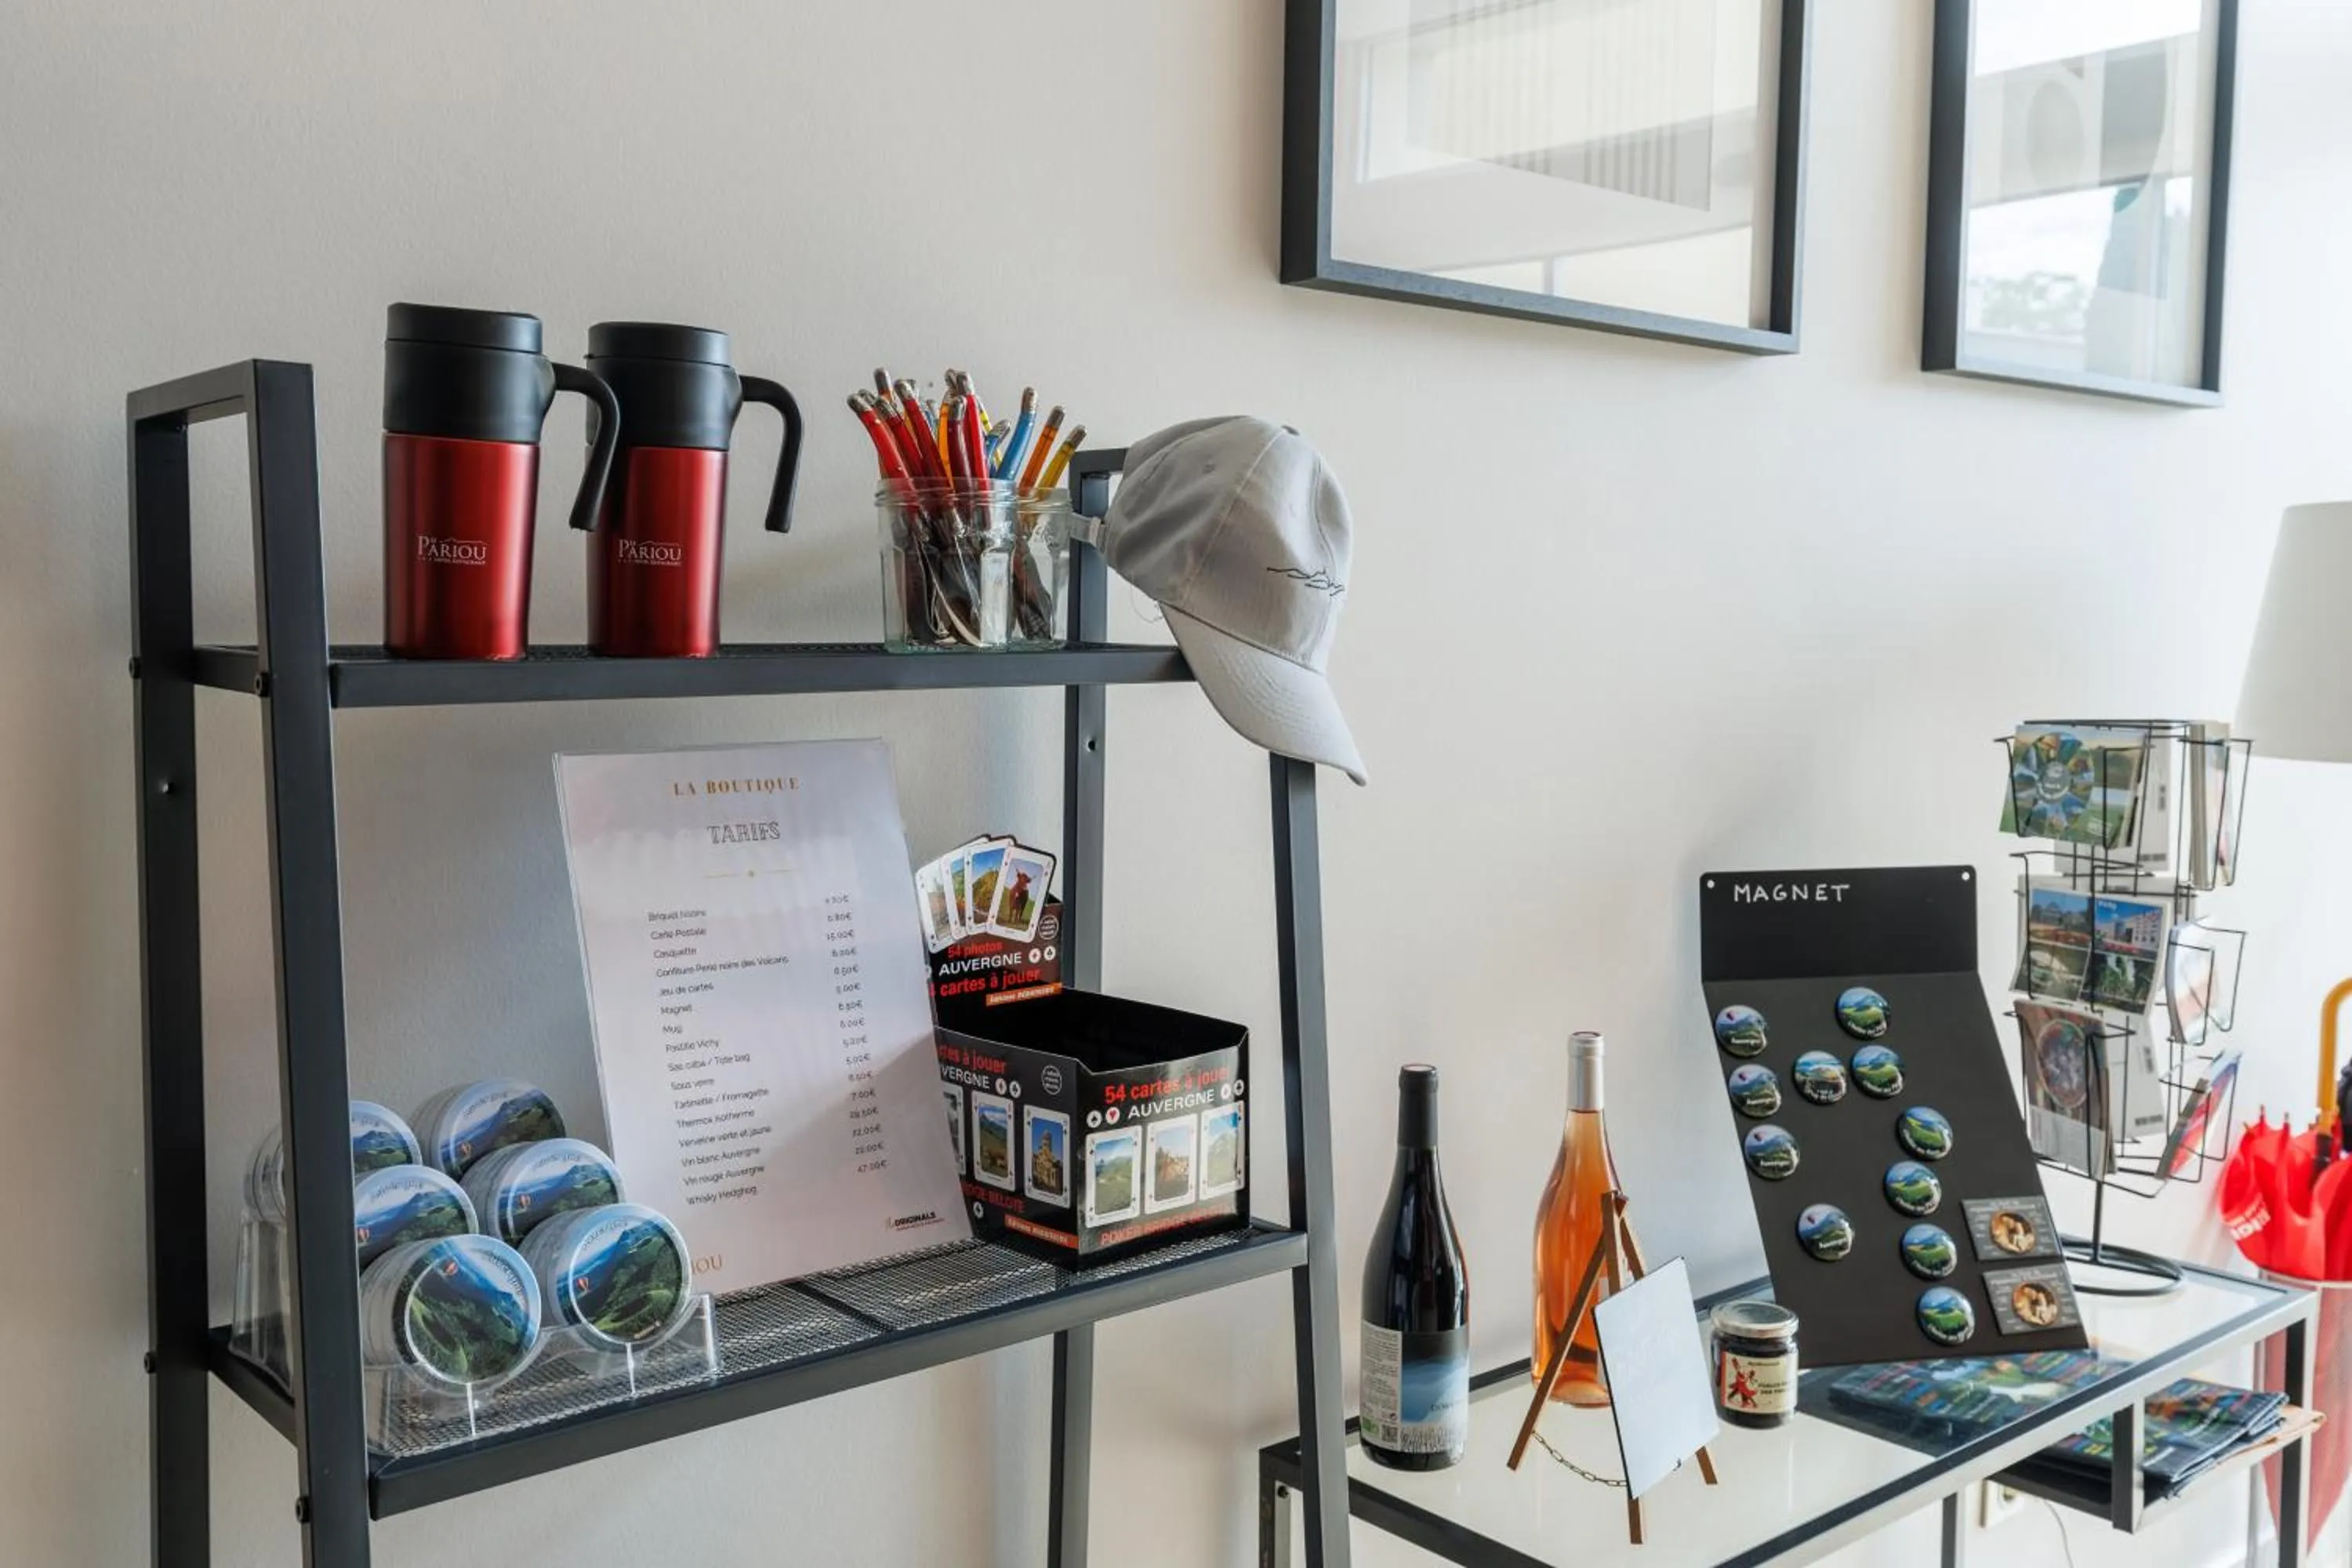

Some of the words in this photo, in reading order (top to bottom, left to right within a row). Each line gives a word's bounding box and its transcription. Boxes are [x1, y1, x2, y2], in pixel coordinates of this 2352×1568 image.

[418, 535, 486, 560] PARIOU
[619, 539, 681, 561] PARIOU
[673, 782, 697, 797] LA
[707, 777, 800, 795] BOUTIQUE
[706, 821, 782, 844] TARIFS
[1733, 883, 1850, 903] MAGNET
[964, 942, 1004, 957] photos
[939, 952, 1022, 976] AUVERGNE
[941, 978, 985, 997] cartes
[989, 972, 999, 989] à
[1001, 969, 1042, 990] jouer
[660, 1004, 693, 1016] Magnet
[973, 1051, 1007, 1075] jouer
[942, 1065, 990, 1089] VERGNE
[1104, 1083, 1127, 1105] 54
[1130, 1077, 1181, 1101] cartes
[1127, 1088, 1215, 1120] AUVERGNE
[894, 1211, 937, 1227] ORIGINALS
[690, 1253, 723, 1275] IOU
